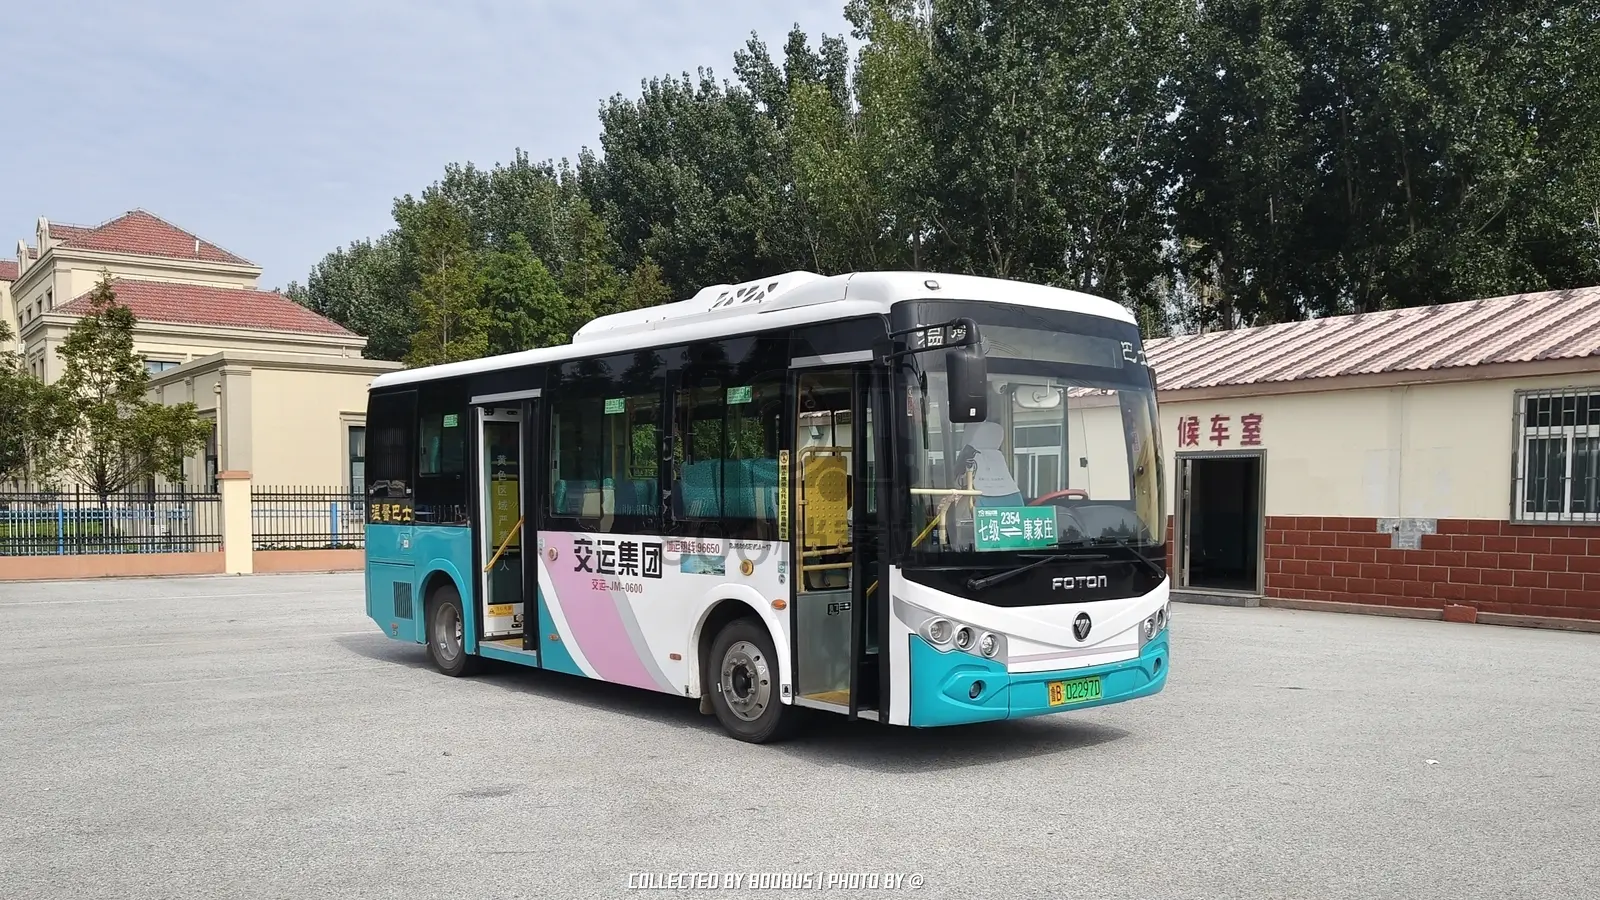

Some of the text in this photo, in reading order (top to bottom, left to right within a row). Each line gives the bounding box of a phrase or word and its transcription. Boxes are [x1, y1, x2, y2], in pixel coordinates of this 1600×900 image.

[1177, 412, 1263, 448] 候车室
[978, 519, 1000, 542] 七级
[1023, 517, 1054, 541] 康家庄
[1000, 511, 1021, 525] 2354
[573, 538, 663, 579] 交运集团
[1052, 575, 1108, 591] FOTON
